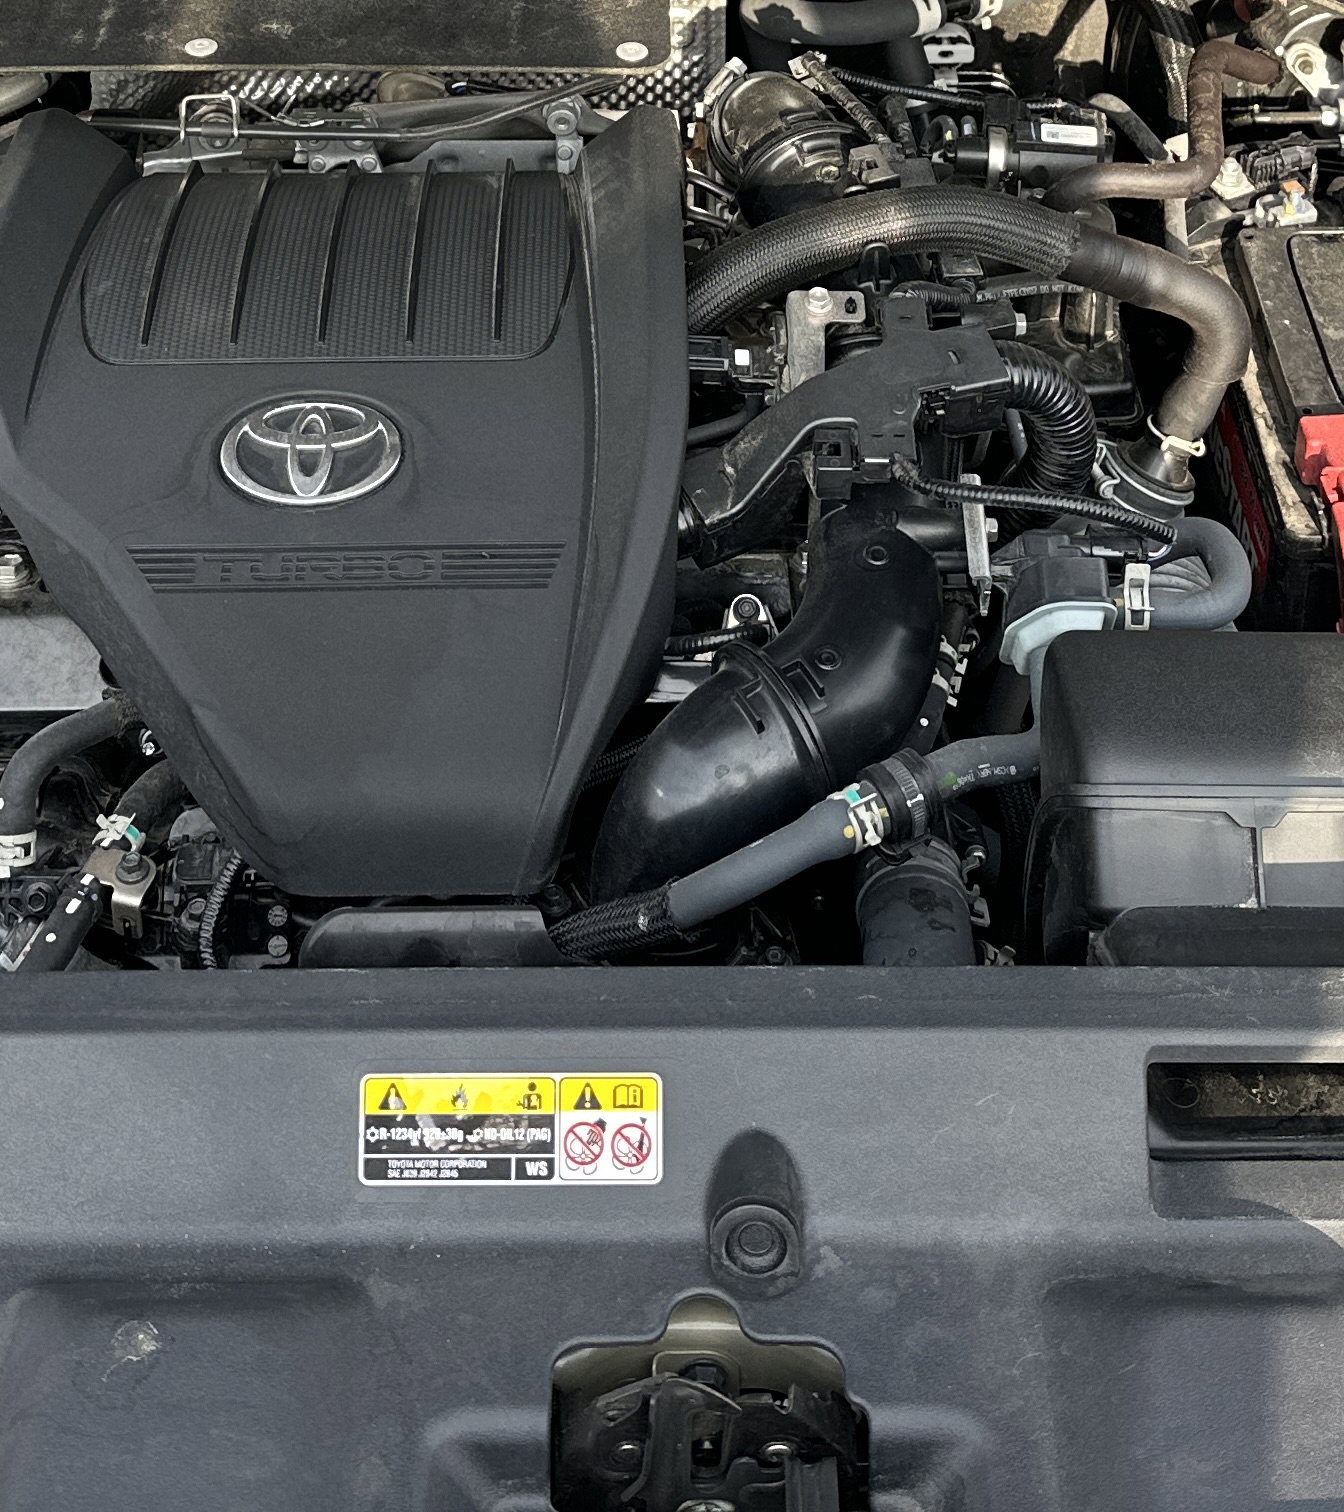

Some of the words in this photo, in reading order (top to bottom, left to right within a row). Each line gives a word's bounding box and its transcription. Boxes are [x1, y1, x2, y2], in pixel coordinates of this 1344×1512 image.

[203, 551, 437, 584] TURBO
[387, 1159, 414, 1169] TOYOTA
[414, 1159, 439, 1169] MOTOR
[439, 1159, 488, 1169] CORPORATION
[525, 1160, 549, 1176] WS
[387, 1169, 401, 1178] SAE
